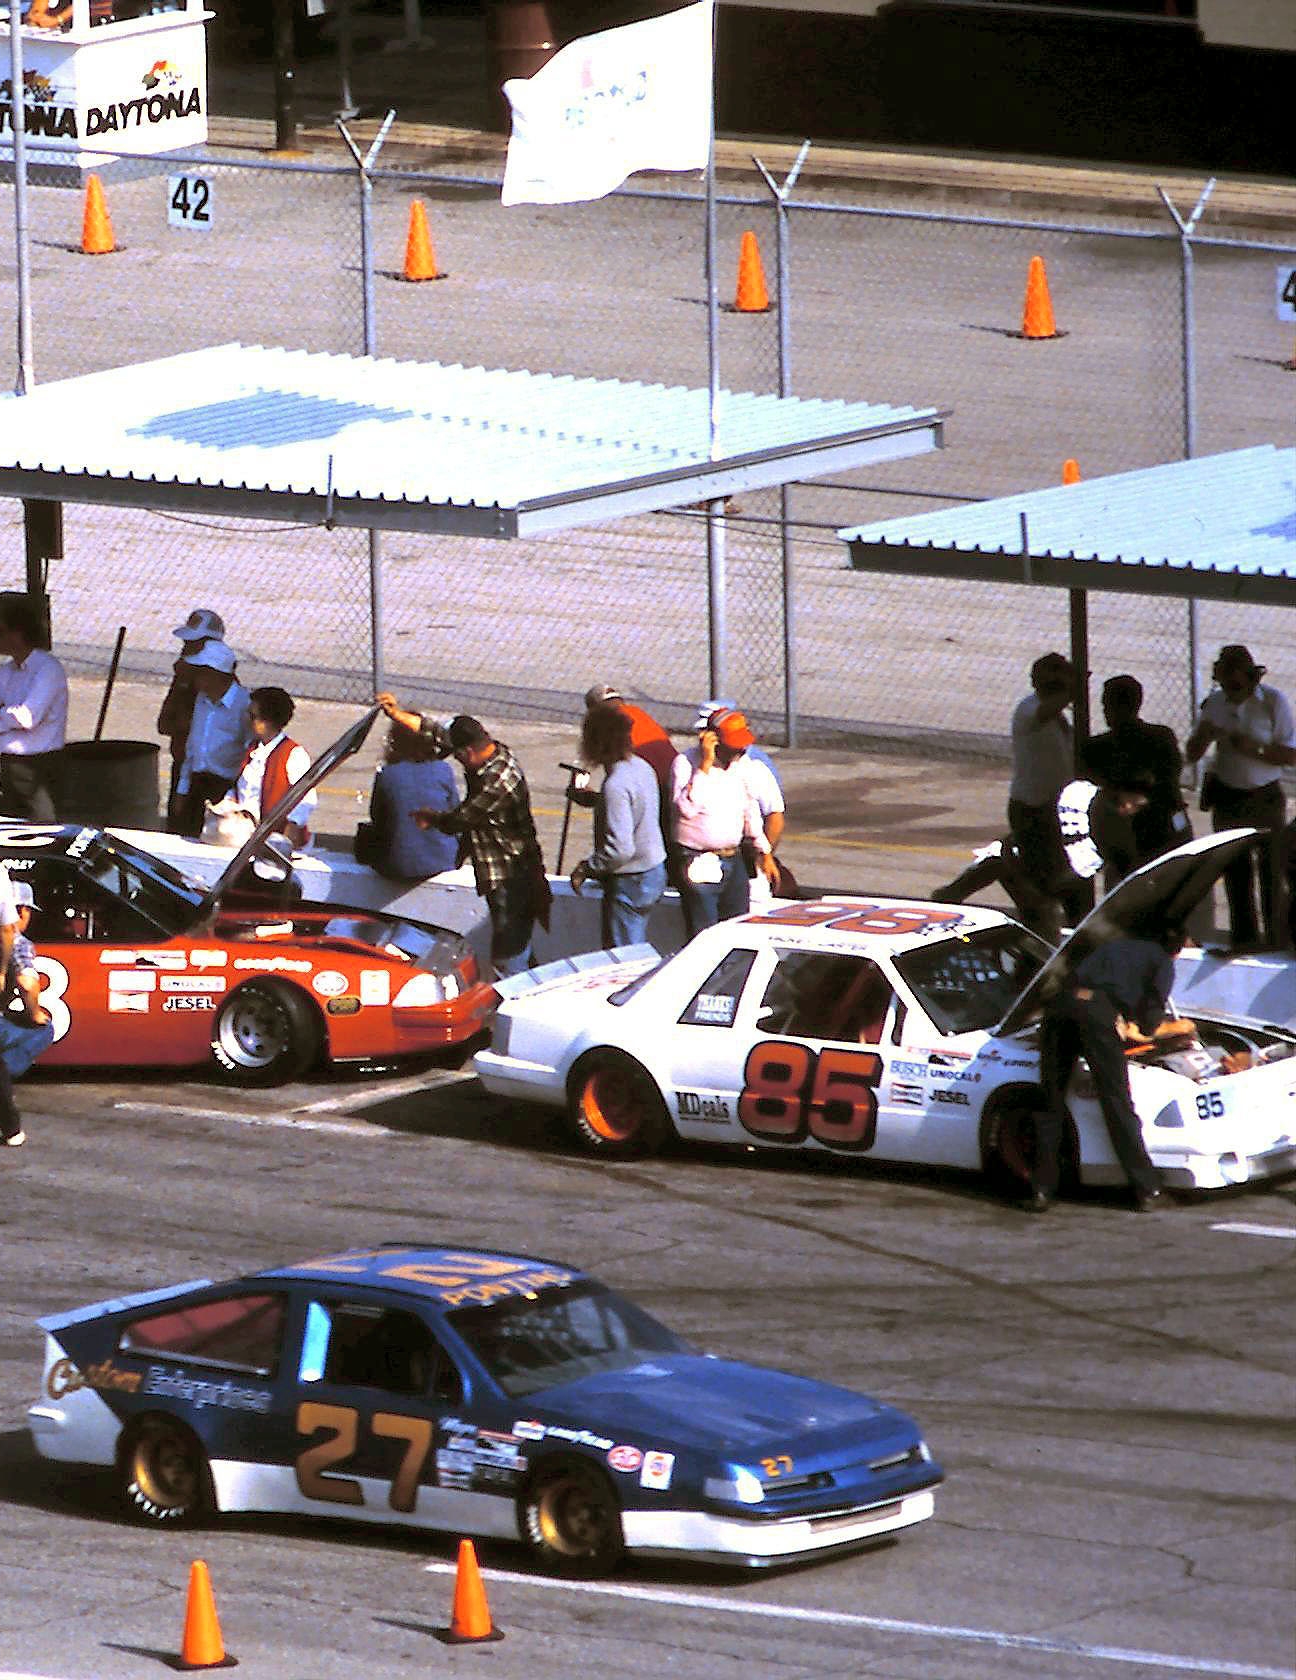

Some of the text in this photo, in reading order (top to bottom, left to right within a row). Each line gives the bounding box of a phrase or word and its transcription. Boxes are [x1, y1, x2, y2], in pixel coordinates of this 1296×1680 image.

[86, 88, 201, 136] DAYTONA
[172, 177, 209, 222] 42
[166, 997, 212, 1009] JESEL
[930, 1069, 976, 1082] UNOCAL
[737, 1041, 884, 1152] 85
[929, 1090, 970, 1106] JESEL
[1196, 1091, 1224, 1120] 85
[296, 1400, 433, 1514] 27
[760, 1455, 793, 1477] 27
